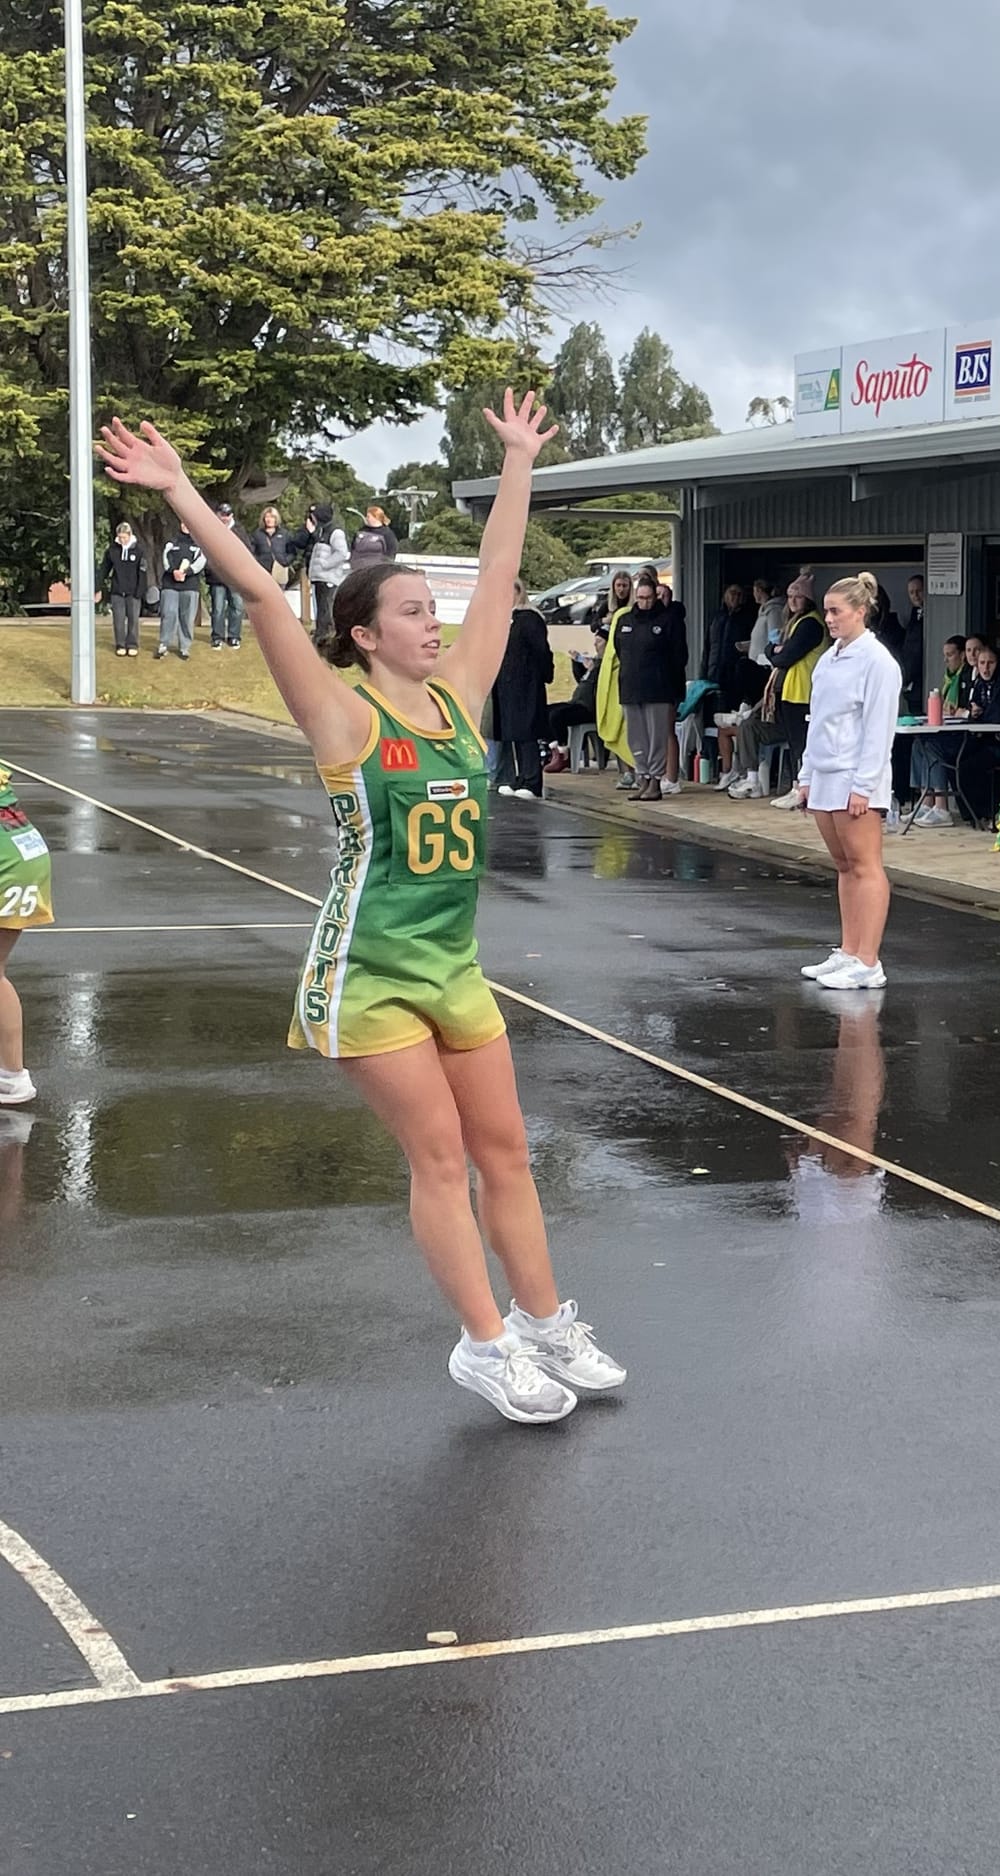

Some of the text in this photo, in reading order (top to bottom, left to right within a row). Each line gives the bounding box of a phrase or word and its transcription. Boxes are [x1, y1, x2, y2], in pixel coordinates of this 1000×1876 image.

[851, 353, 932, 418] Saputo
[957, 352, 989, 385] BJS
[407, 799, 480, 875] GS
[0, 884, 39, 917] 25
[302, 792, 366, 1026] PARROTS
